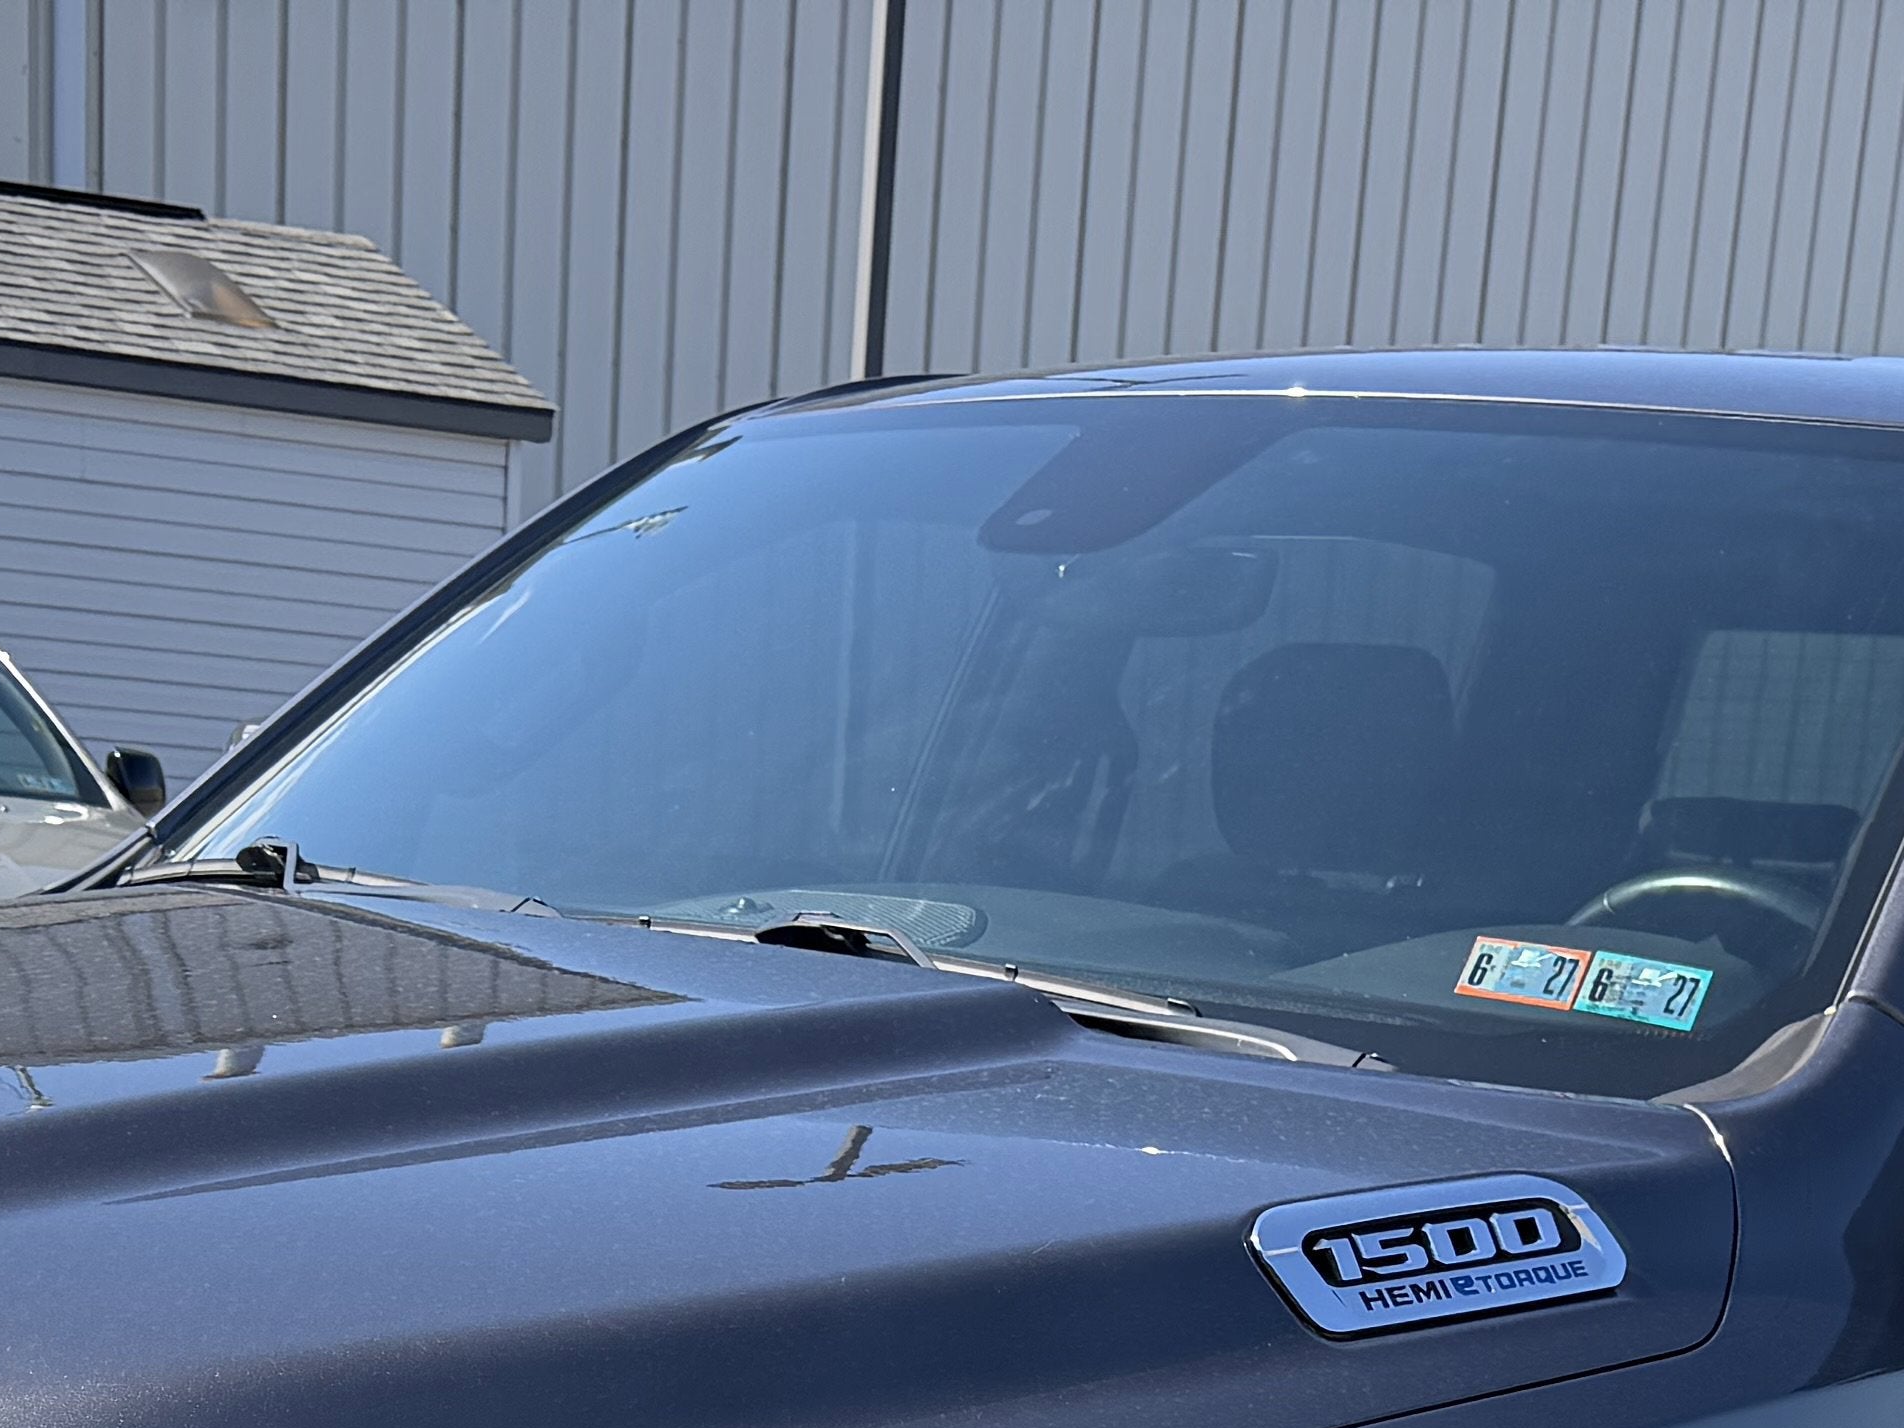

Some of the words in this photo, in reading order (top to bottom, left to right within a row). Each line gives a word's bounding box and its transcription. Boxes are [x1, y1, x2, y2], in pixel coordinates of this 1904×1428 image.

[1467, 953, 1494, 986] 6
[1542, 956, 1580, 1000] 27
[1588, 967, 1614, 1002] 6
[1663, 974, 1700, 1017] 27
[1313, 1207, 1562, 1281] 1500
[1359, 1279, 1453, 1311] HEMI
